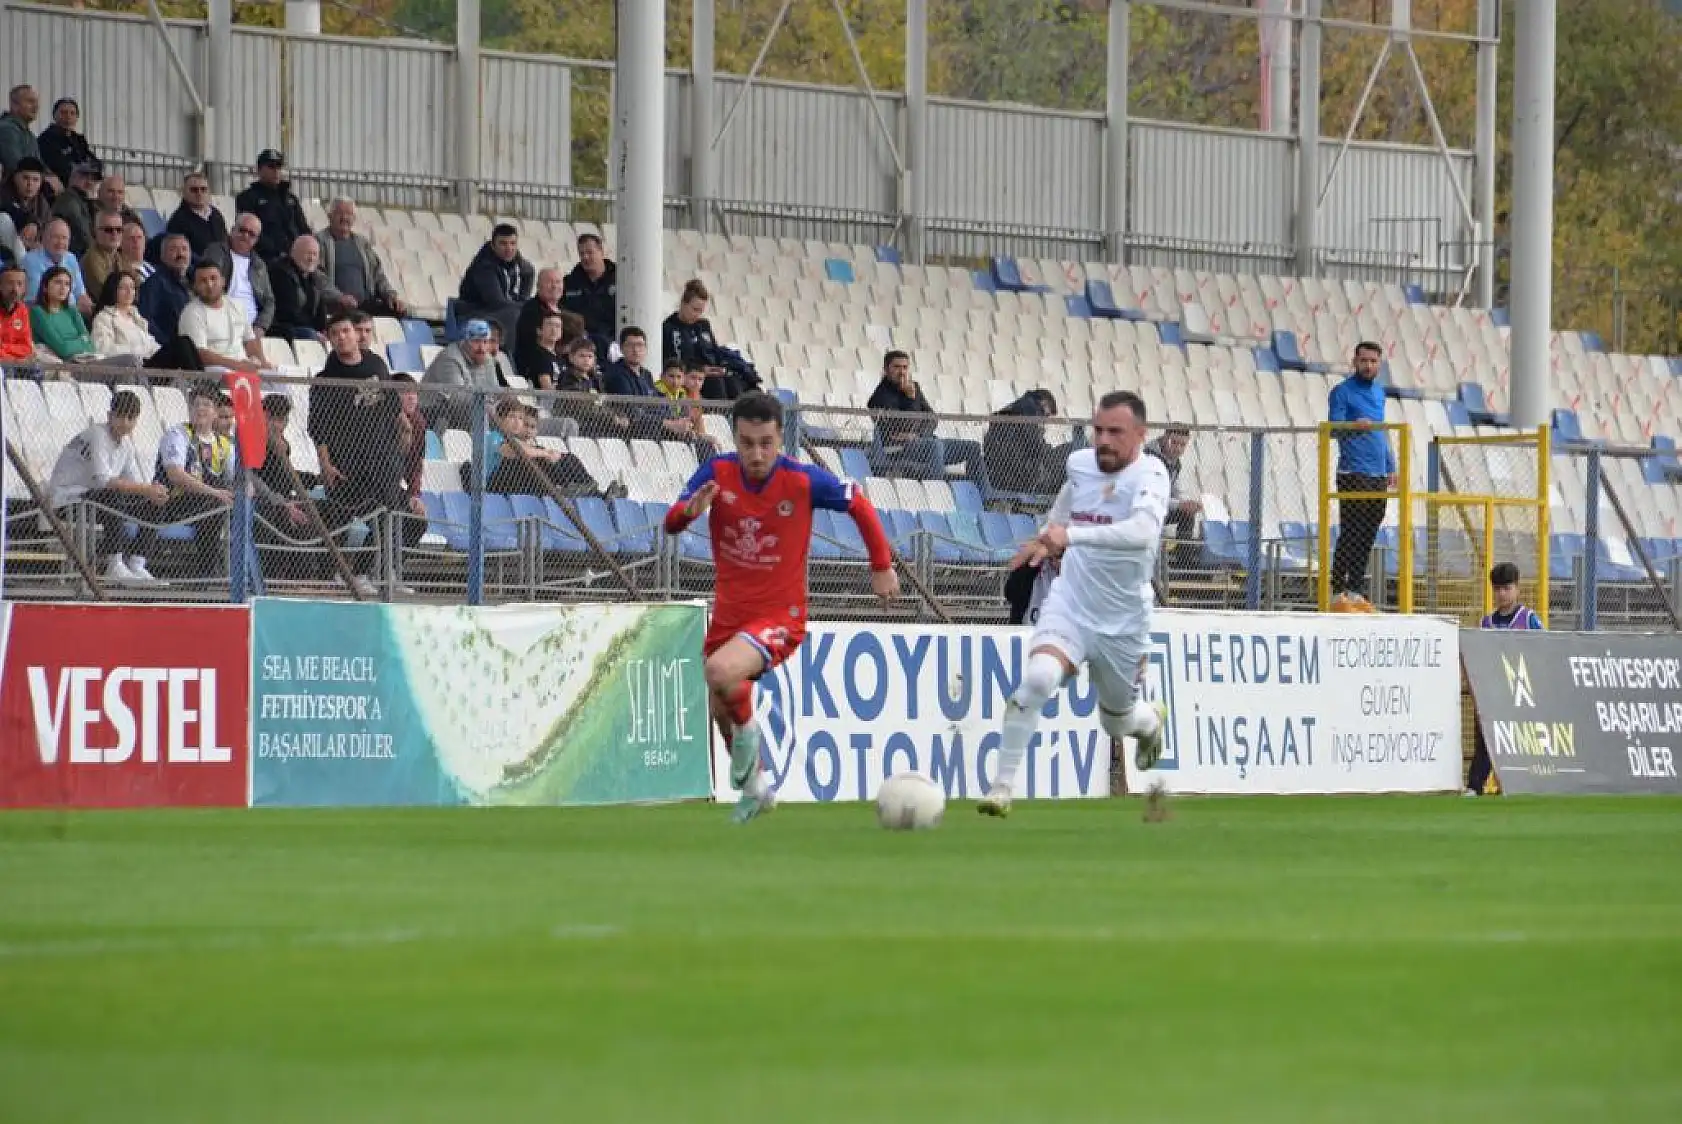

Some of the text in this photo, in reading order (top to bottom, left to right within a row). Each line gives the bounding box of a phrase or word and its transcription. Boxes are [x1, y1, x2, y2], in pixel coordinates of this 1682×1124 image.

[262, 655, 292, 681] SEA
[296, 655, 319, 681] ME
[802, 630, 1097, 719] KOYUNU
[1183, 632, 1320, 683] HERDEM
[27, 666, 232, 764] VESTEL
[261, 689, 382, 720] FETHİYESPOR'A
[1360, 678, 1410, 716] GÜVEN
[259, 733, 348, 763] BAŞARILAR
[1195, 703, 1316, 779] İNŞAAT
[1627, 738, 1677, 777] DİLER
